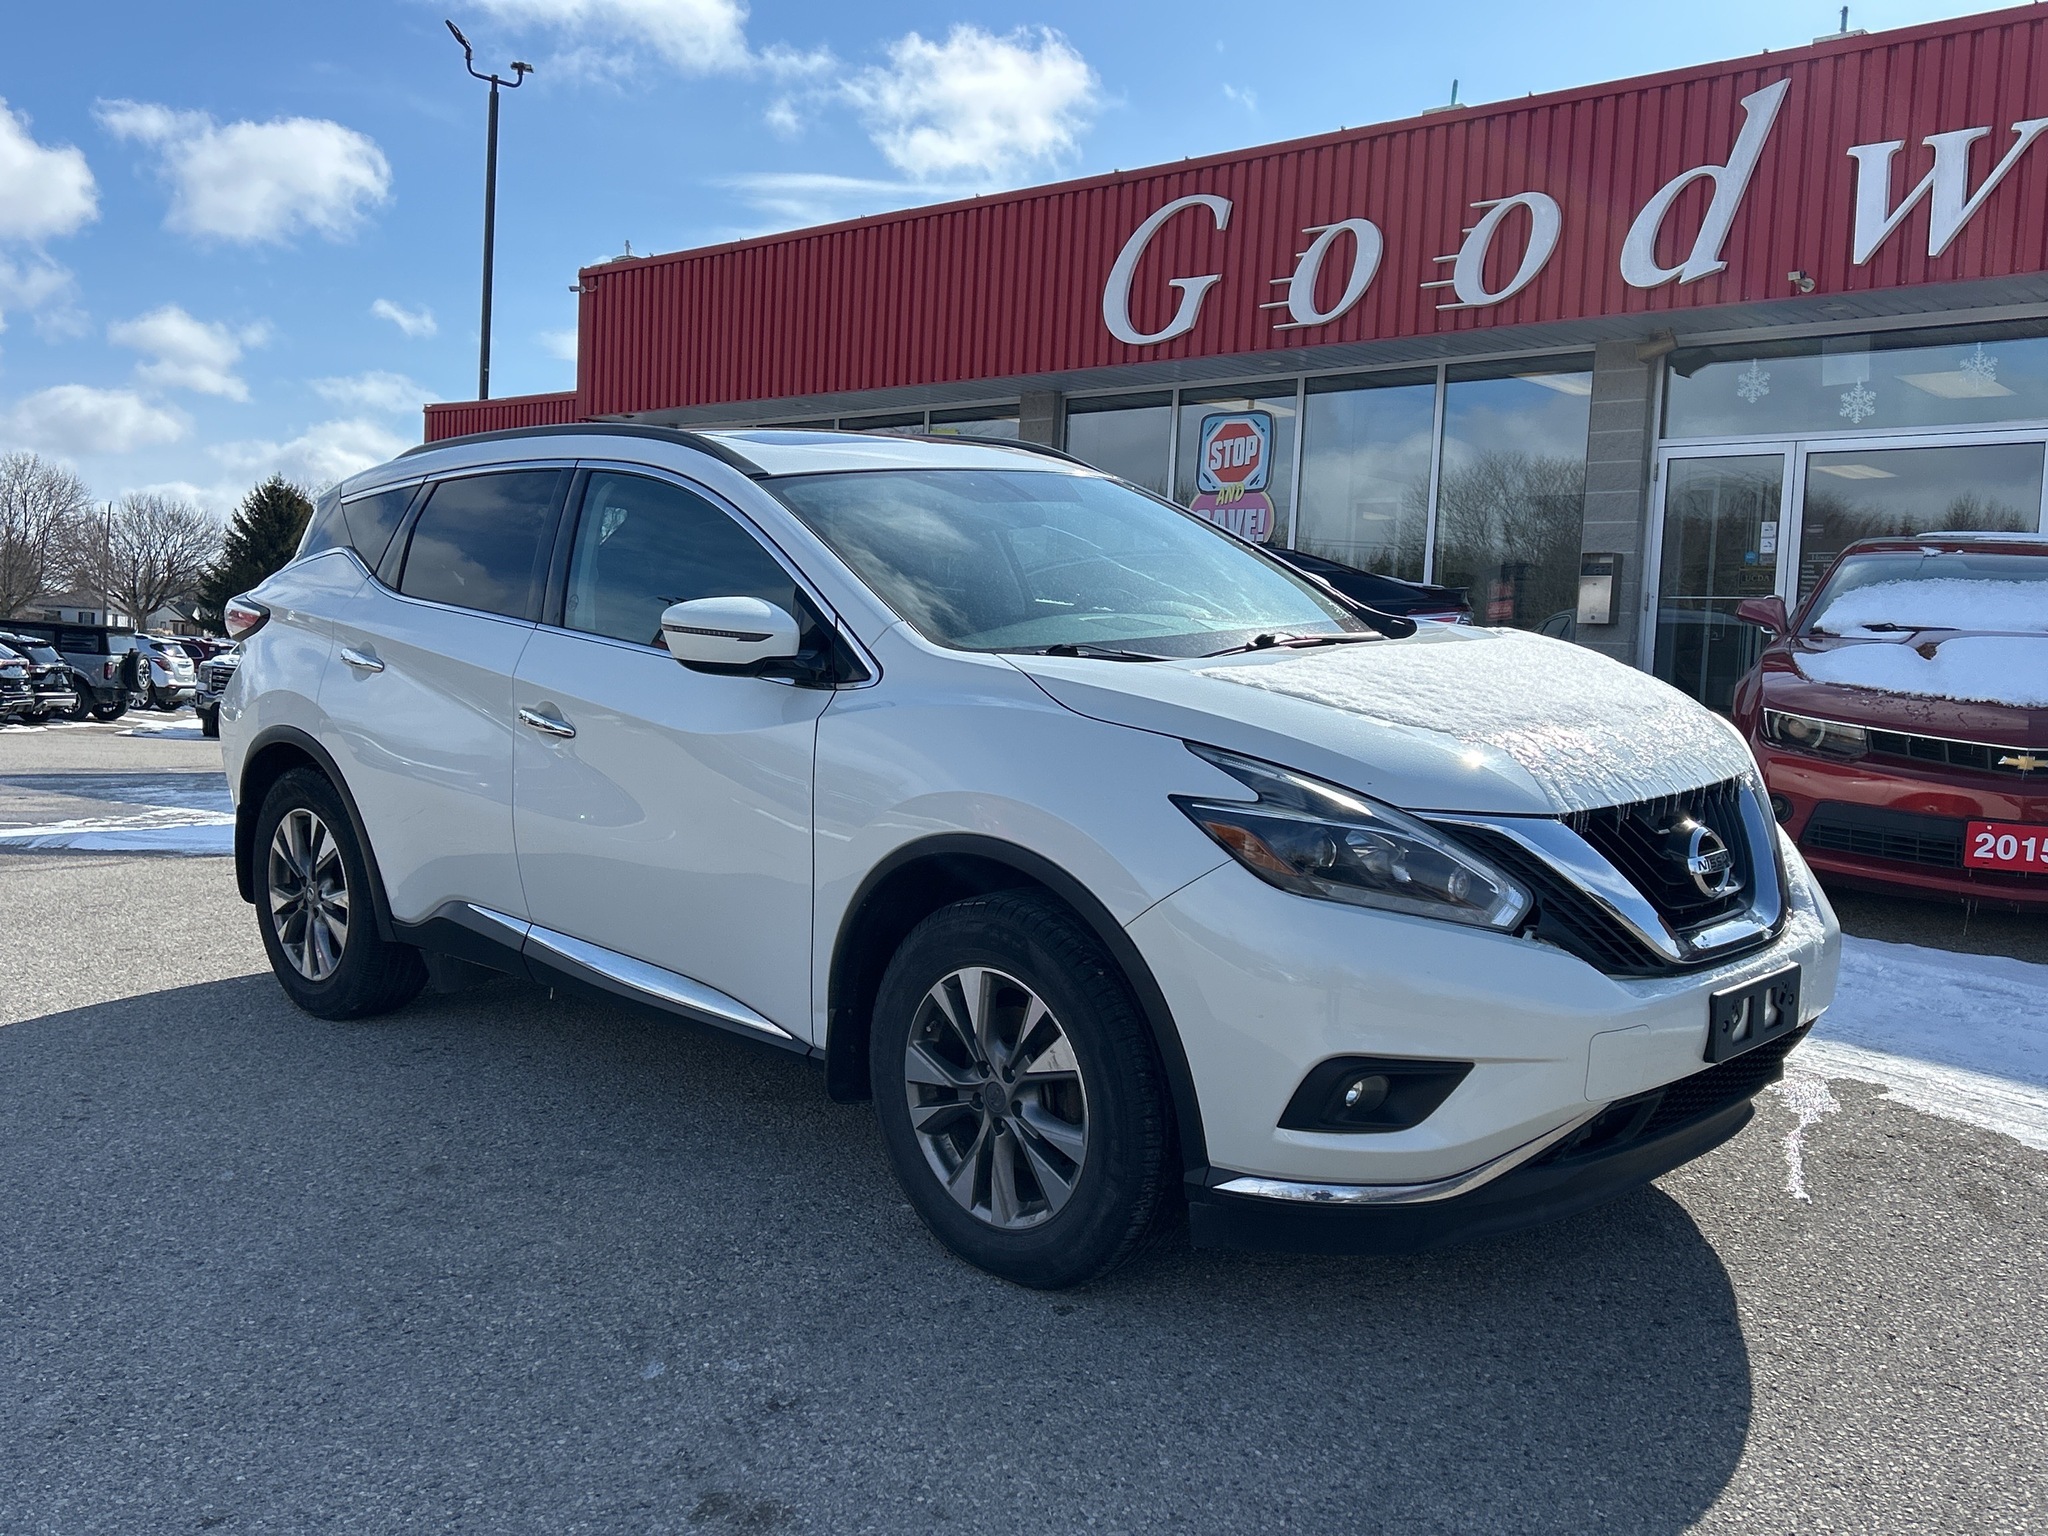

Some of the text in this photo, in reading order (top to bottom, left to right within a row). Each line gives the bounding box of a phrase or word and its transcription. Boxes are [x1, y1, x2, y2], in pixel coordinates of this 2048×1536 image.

[1102, 77, 2048, 345] Goodw
[1210, 435, 1258, 471] STOP
[1215, 482, 1245, 506] AND
[1697, 853, 1731, 872] NISSA
